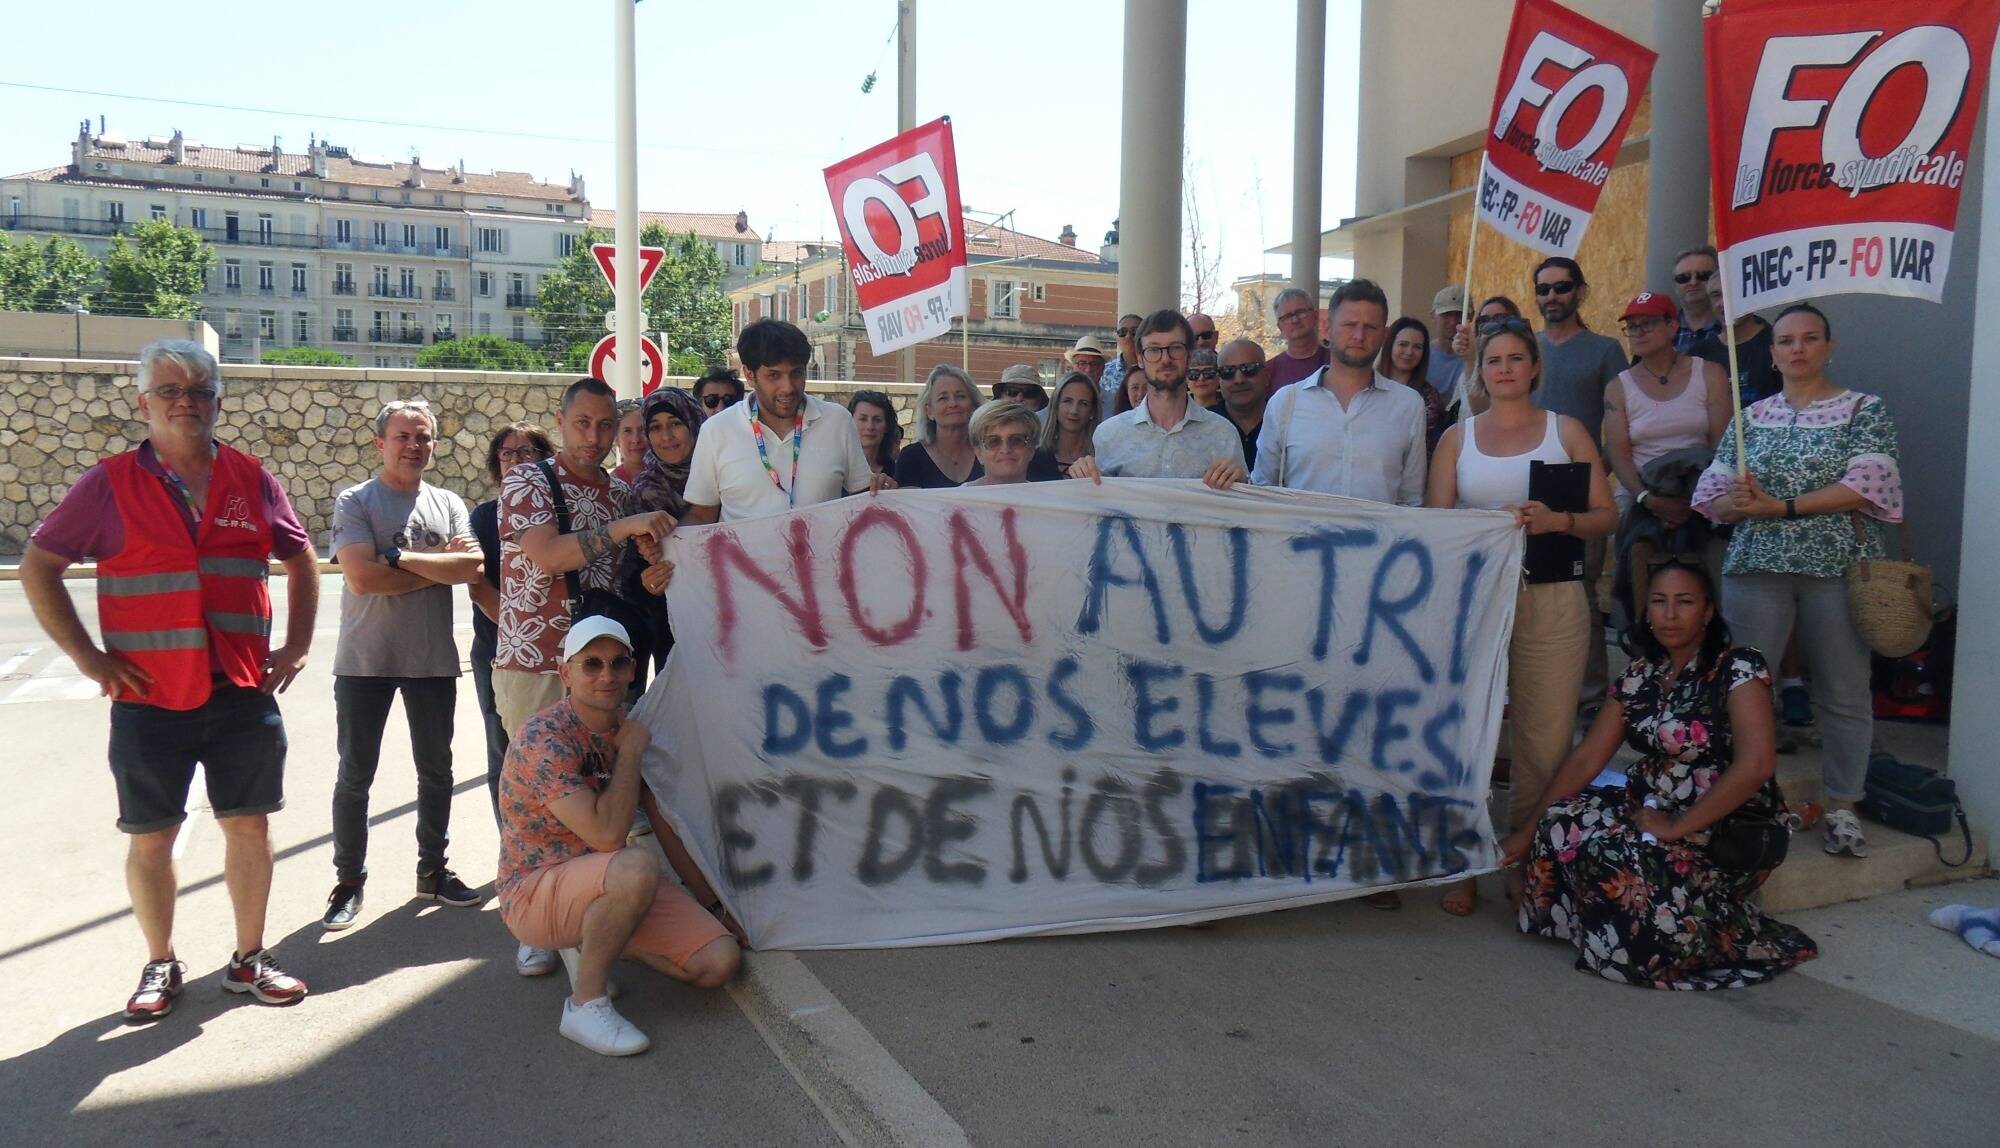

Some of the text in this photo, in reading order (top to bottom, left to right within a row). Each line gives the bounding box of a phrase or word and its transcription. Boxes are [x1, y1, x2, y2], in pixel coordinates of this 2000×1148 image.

[1494, 30, 1629, 171] FO
[1732, 25, 1971, 210] FO
[1537, 142, 1609, 186] syndicale
[1735, 145, 1965, 203] la force syndicale
[1540, 209, 1571, 248] VAR
[1889, 236, 1935, 283] VAR
[223, 495, 249, 521] FO
[704, 505, 1488, 686] NON AU TRI
[762, 655, 1474, 791] DE NOS ELEVES
[716, 773, 858, 890] ET
[857, 775, 993, 886] DE
[1010, 766, 1188, 887] NOS
